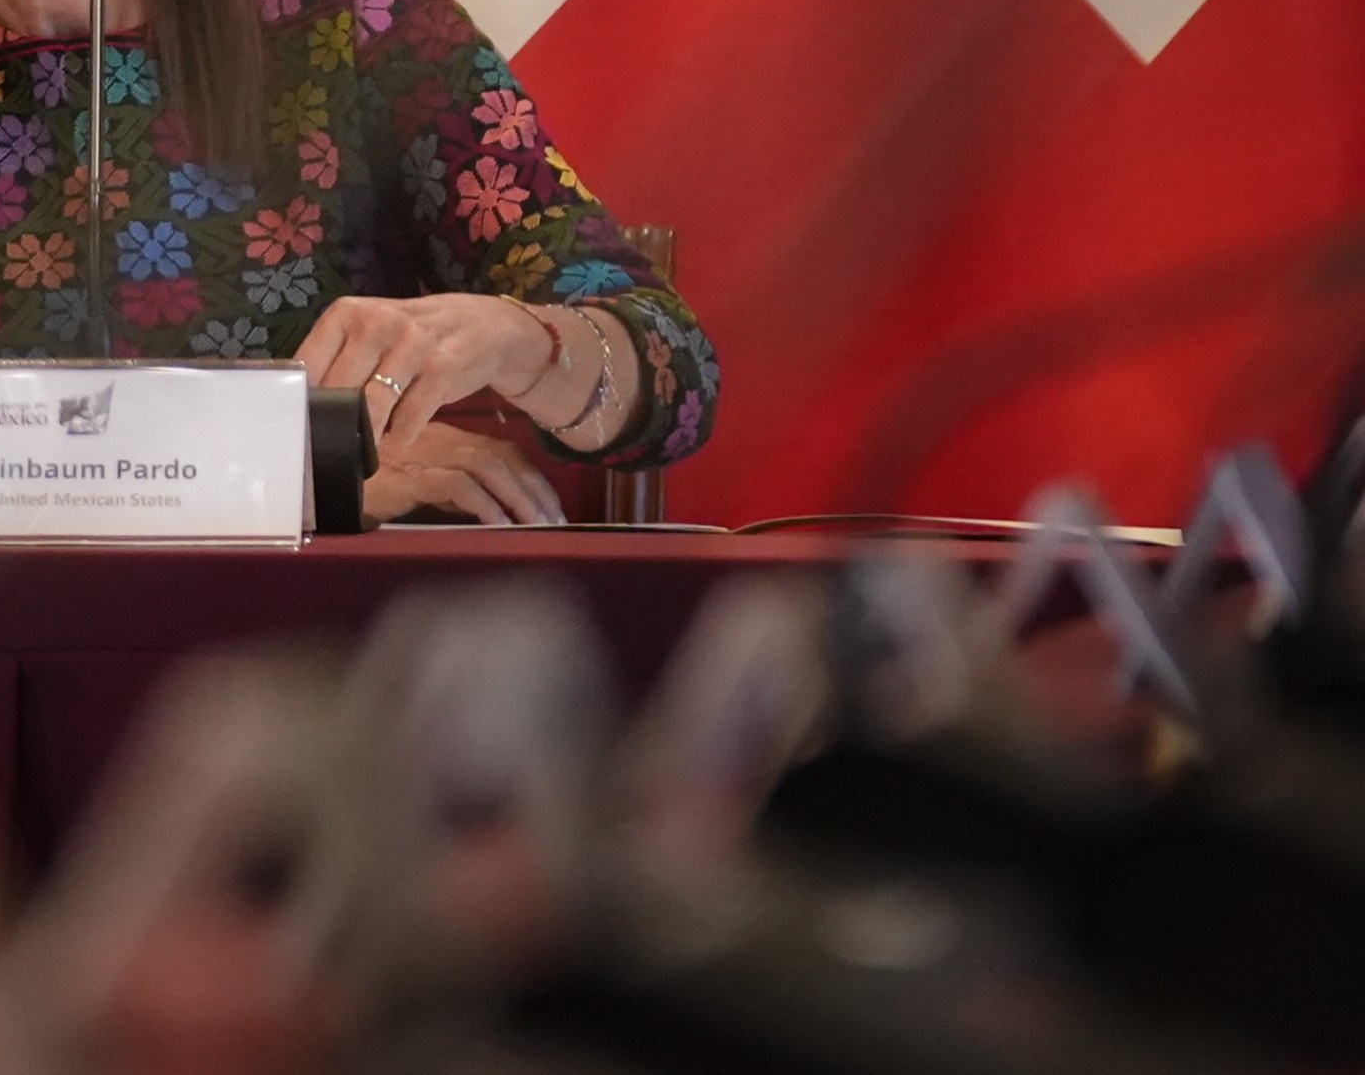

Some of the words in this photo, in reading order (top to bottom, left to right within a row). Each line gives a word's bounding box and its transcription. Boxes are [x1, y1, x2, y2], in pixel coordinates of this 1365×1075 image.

[117, 459, 198, 480] Pardo
[54, 492, 126, 507] Mexican
[131, 493, 182, 508] States
